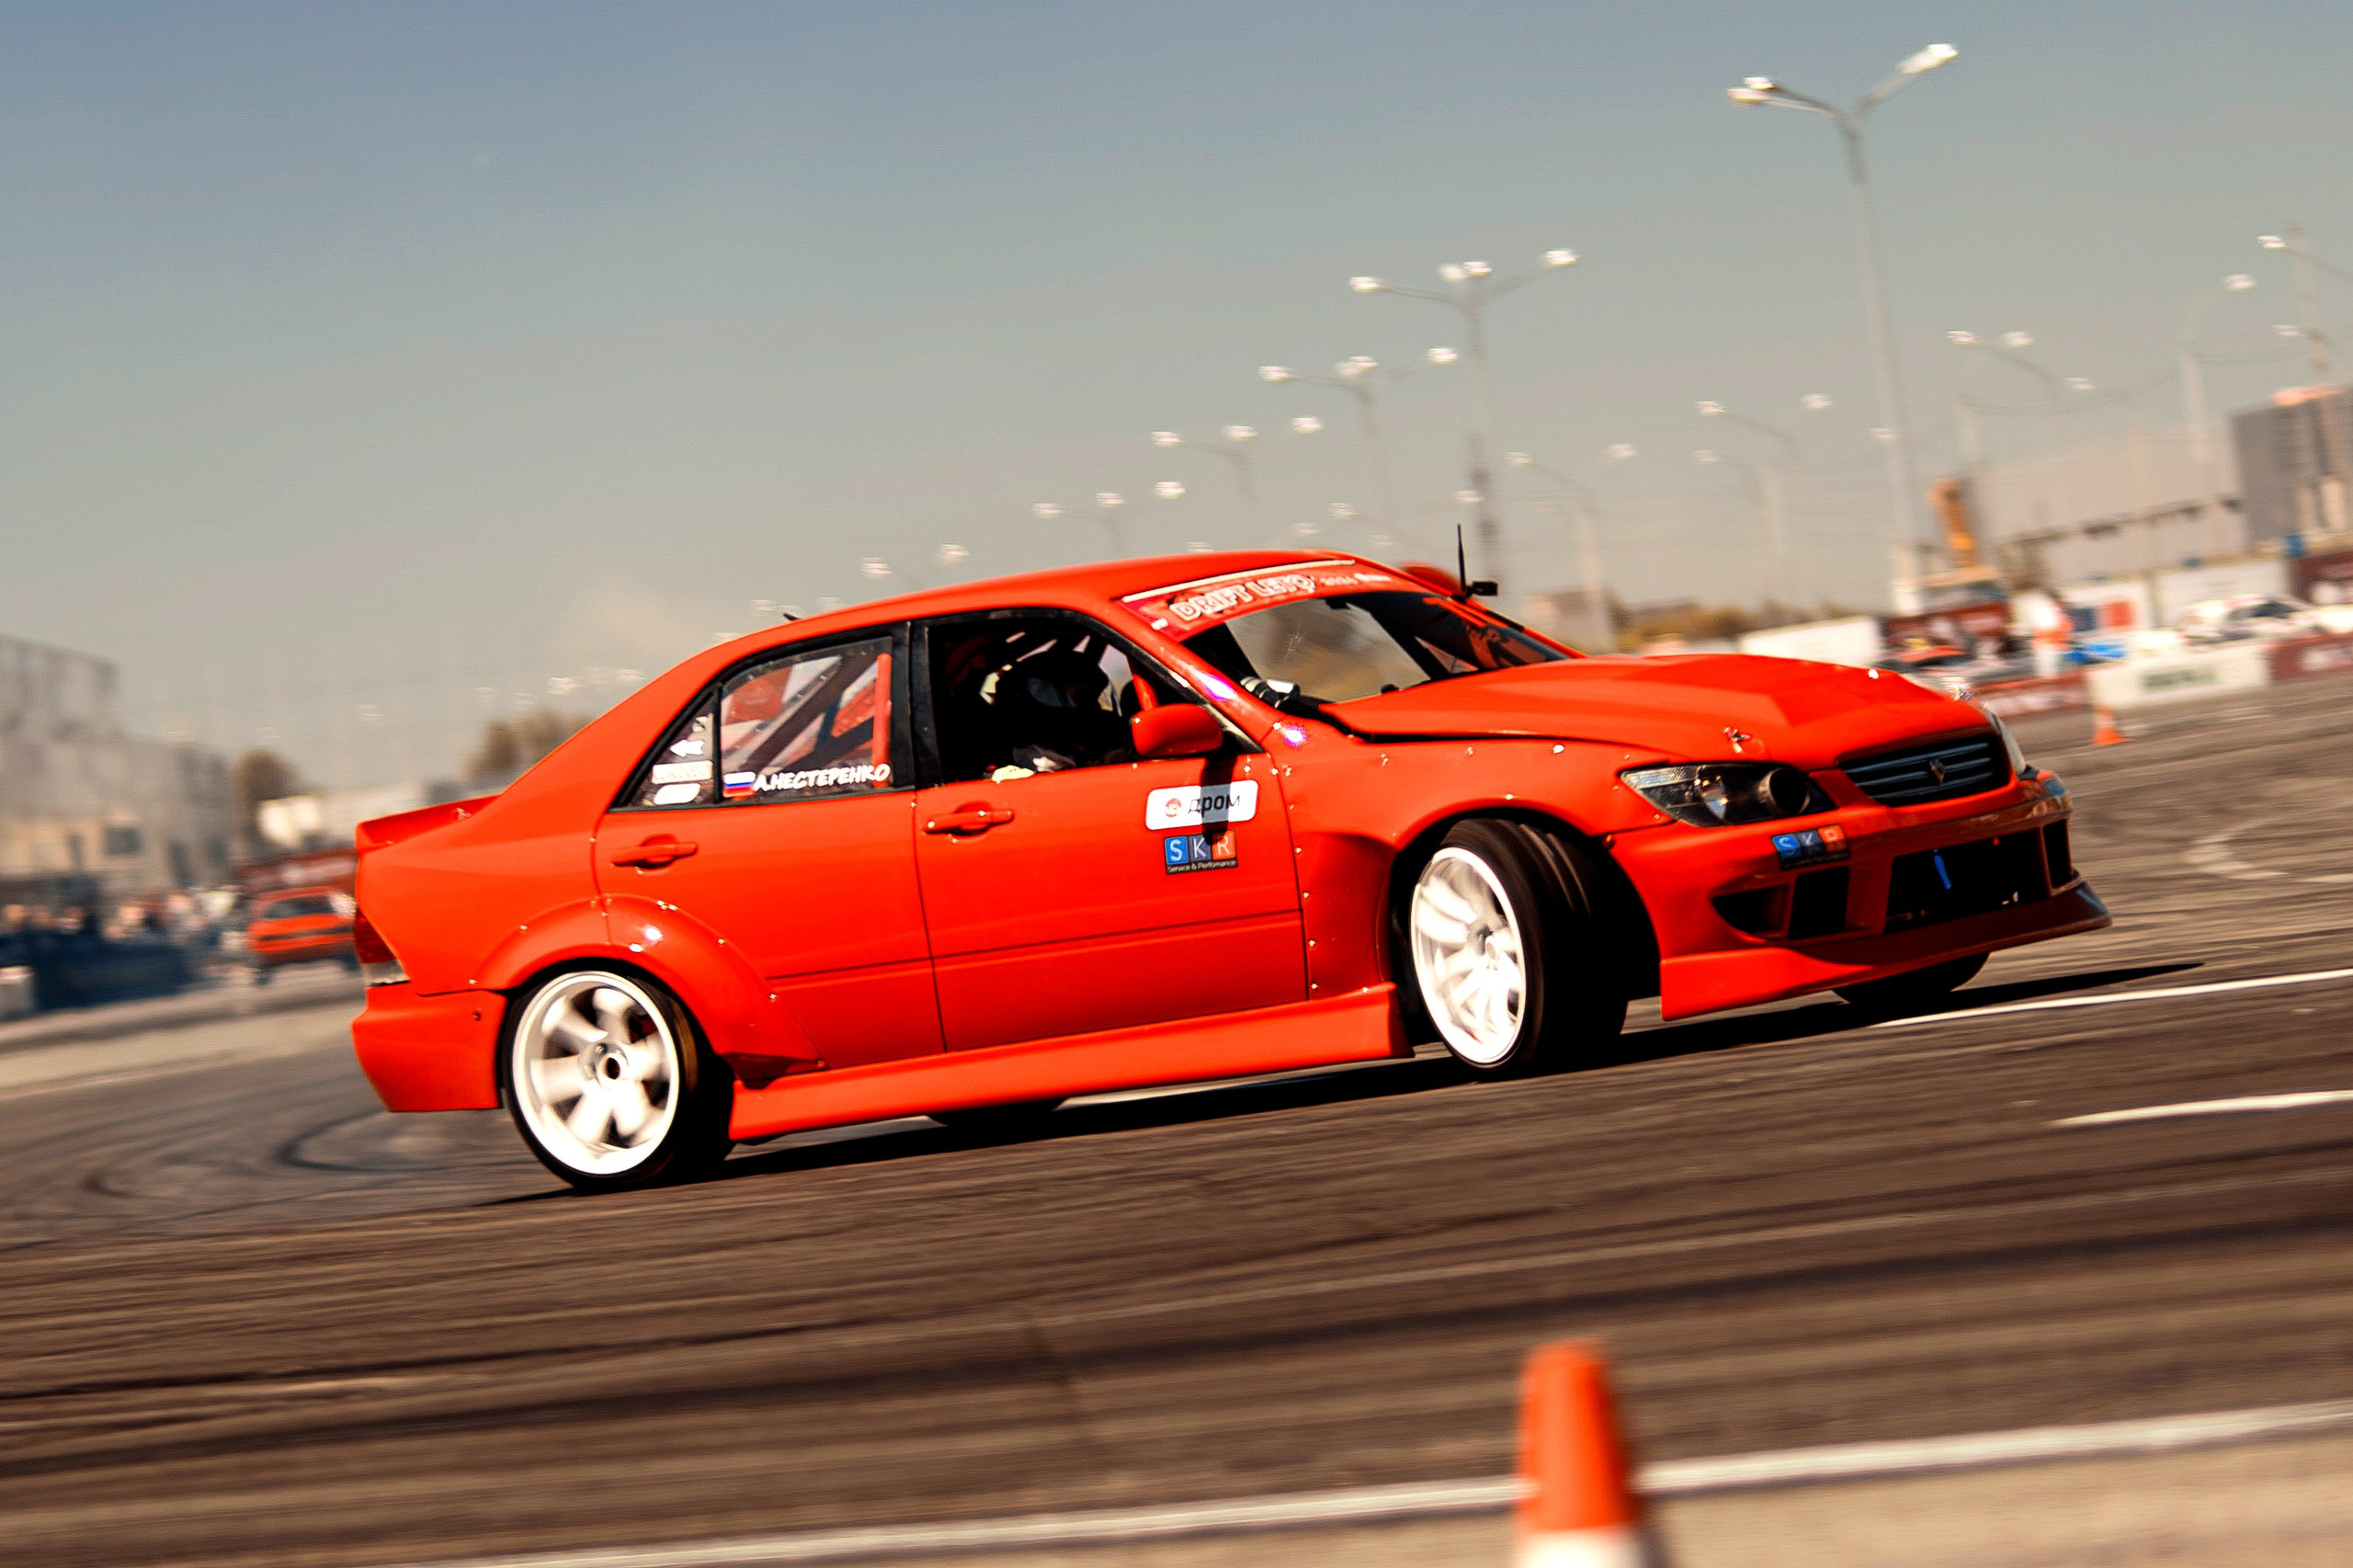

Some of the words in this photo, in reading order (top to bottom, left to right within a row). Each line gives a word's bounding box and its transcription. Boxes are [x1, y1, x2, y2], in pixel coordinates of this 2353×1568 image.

[1169, 584, 1253, 621] DRIFT
[1188, 794, 1241, 818] дром
[1169, 831, 1232, 862] SKR
